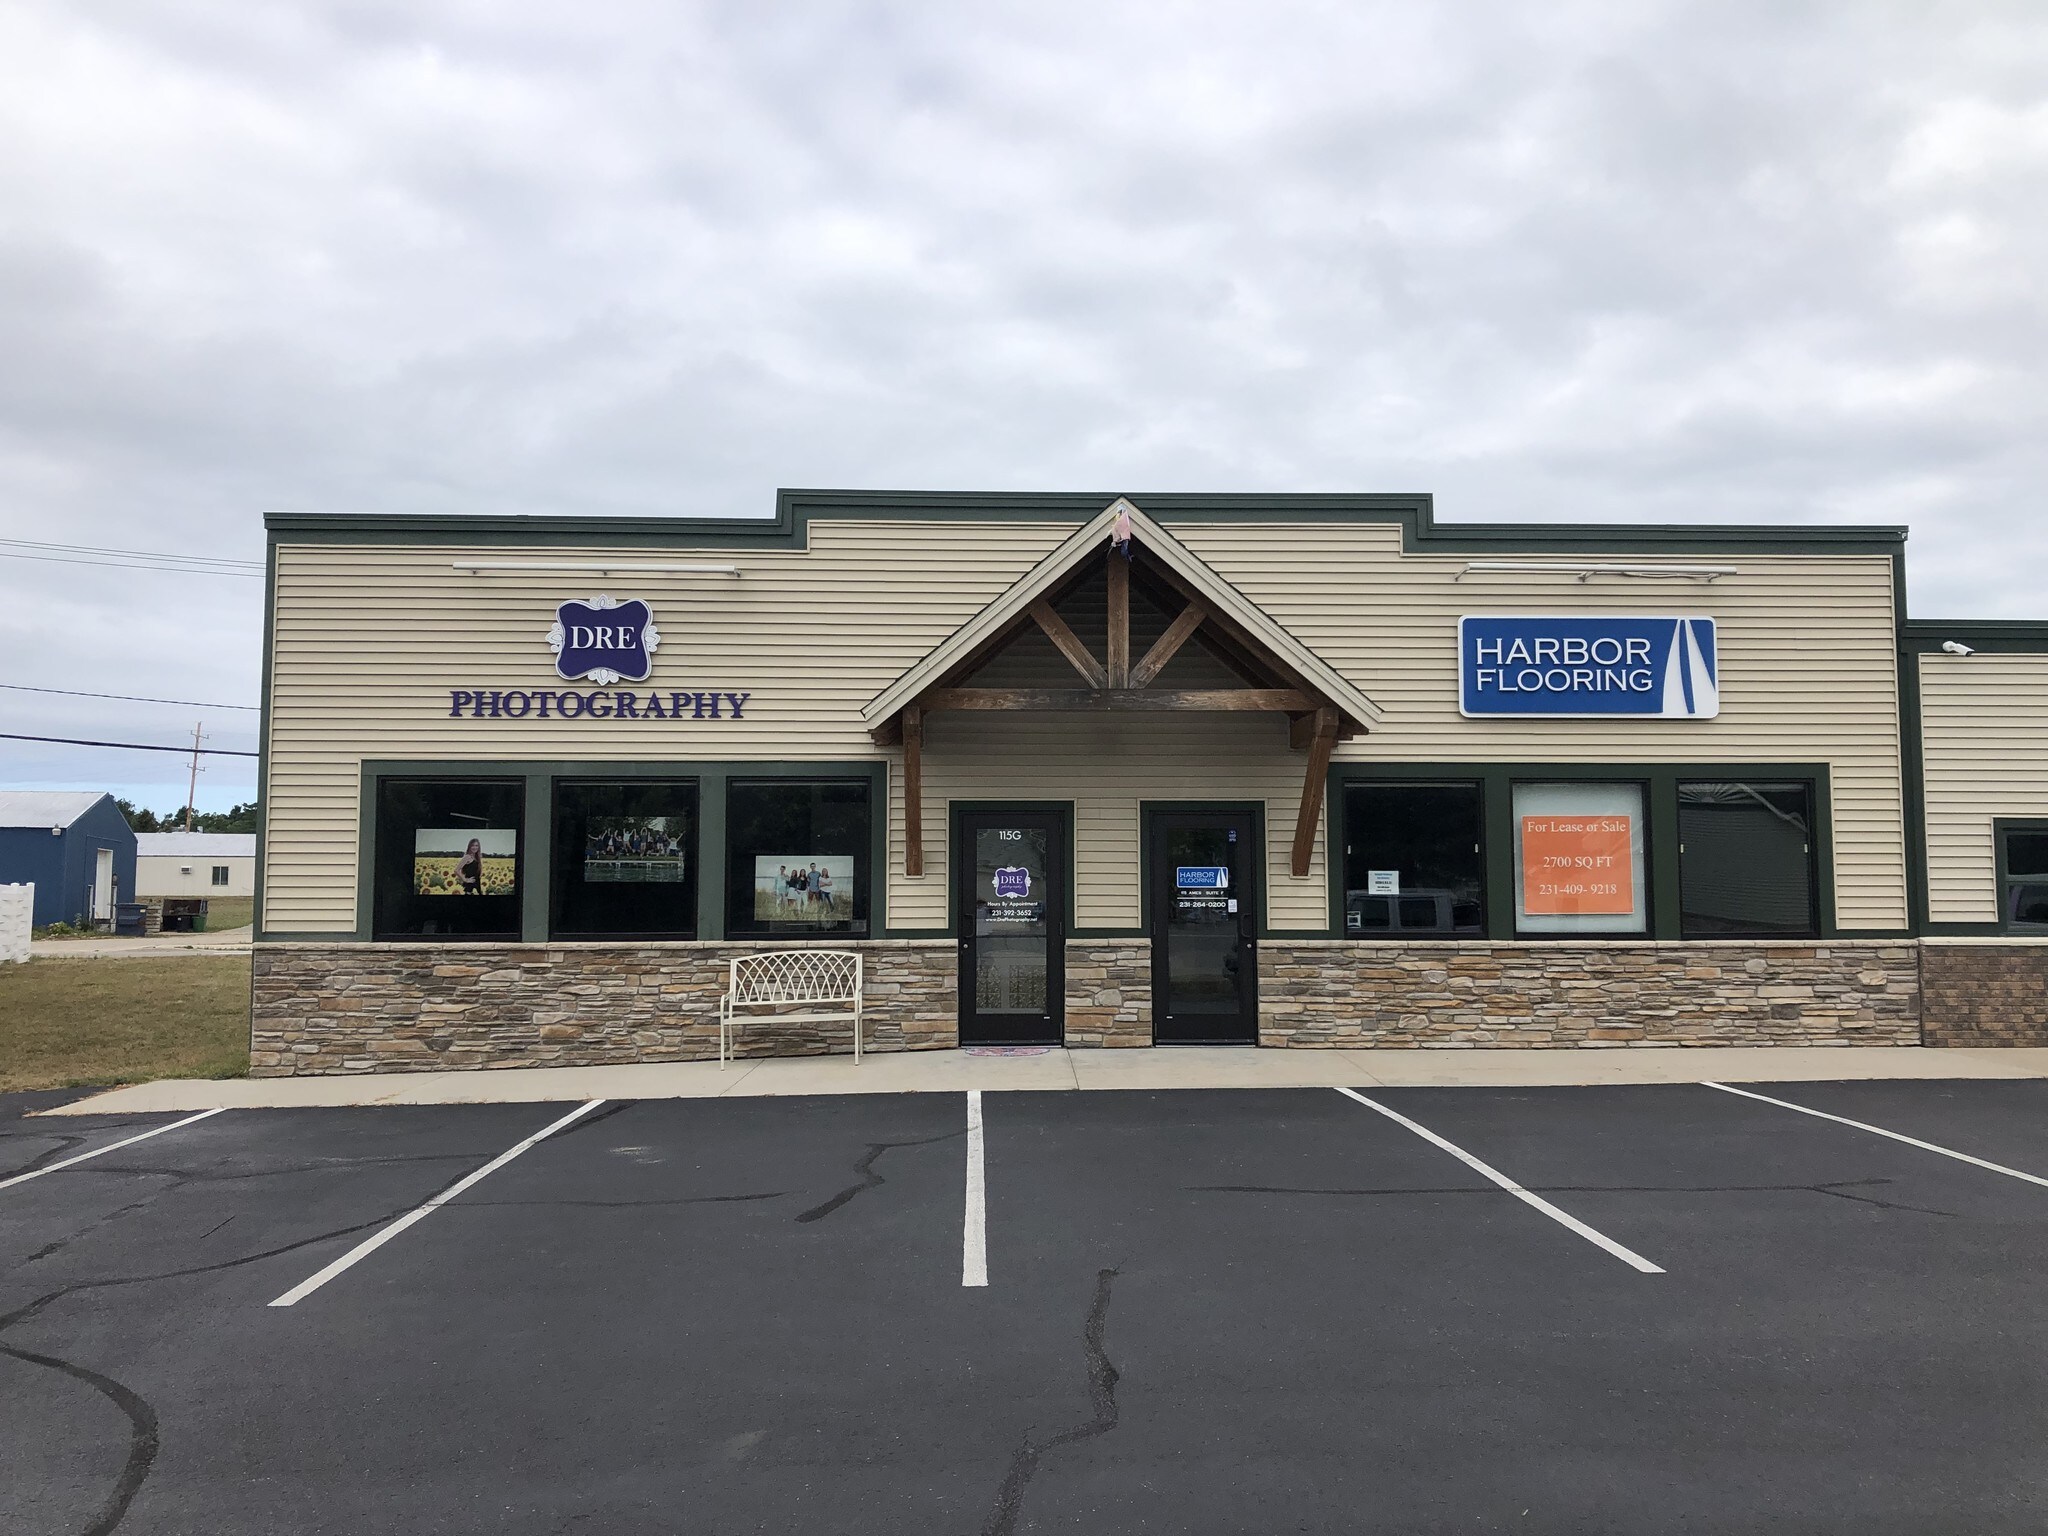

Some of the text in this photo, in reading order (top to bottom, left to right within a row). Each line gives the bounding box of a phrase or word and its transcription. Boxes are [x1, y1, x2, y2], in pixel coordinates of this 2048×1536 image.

[570, 626, 636, 649] DRE
[1476, 638, 1652, 665] HARBOR
[1476, 669, 1653, 692] FLOORING
[449, 690, 751, 719] PHOTOGRAPHY
[999, 830, 1022, 840] 115G
[1527, 821, 1626, 832] For Lease or Sale
[1543, 856, 1613, 870] 2700 SQ FT
[1001, 875, 1023, 884] DRE
